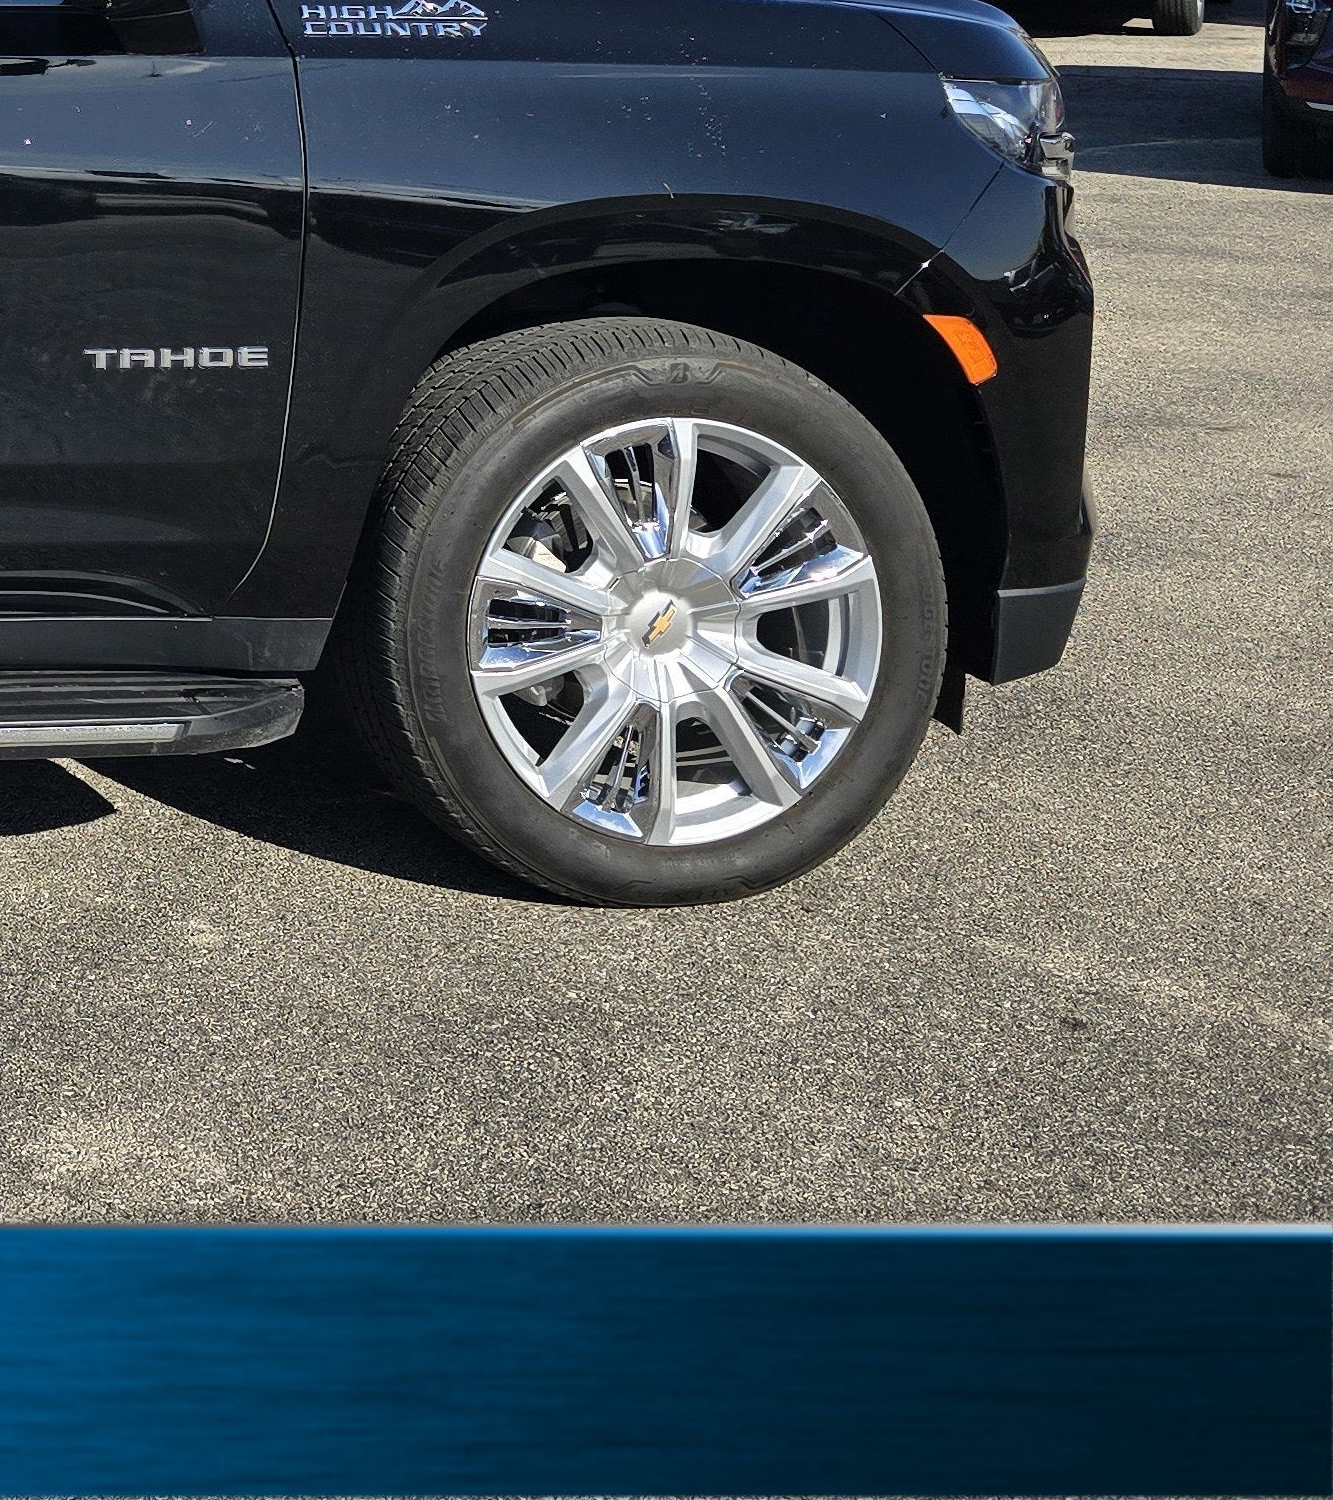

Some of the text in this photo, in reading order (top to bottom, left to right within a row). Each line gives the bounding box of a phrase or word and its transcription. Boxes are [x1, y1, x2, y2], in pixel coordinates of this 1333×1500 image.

[300, 4, 395, 20] HIGH
[303, 20, 488, 38] COUNTRY
[83, 347, 269, 370] TAHOE
